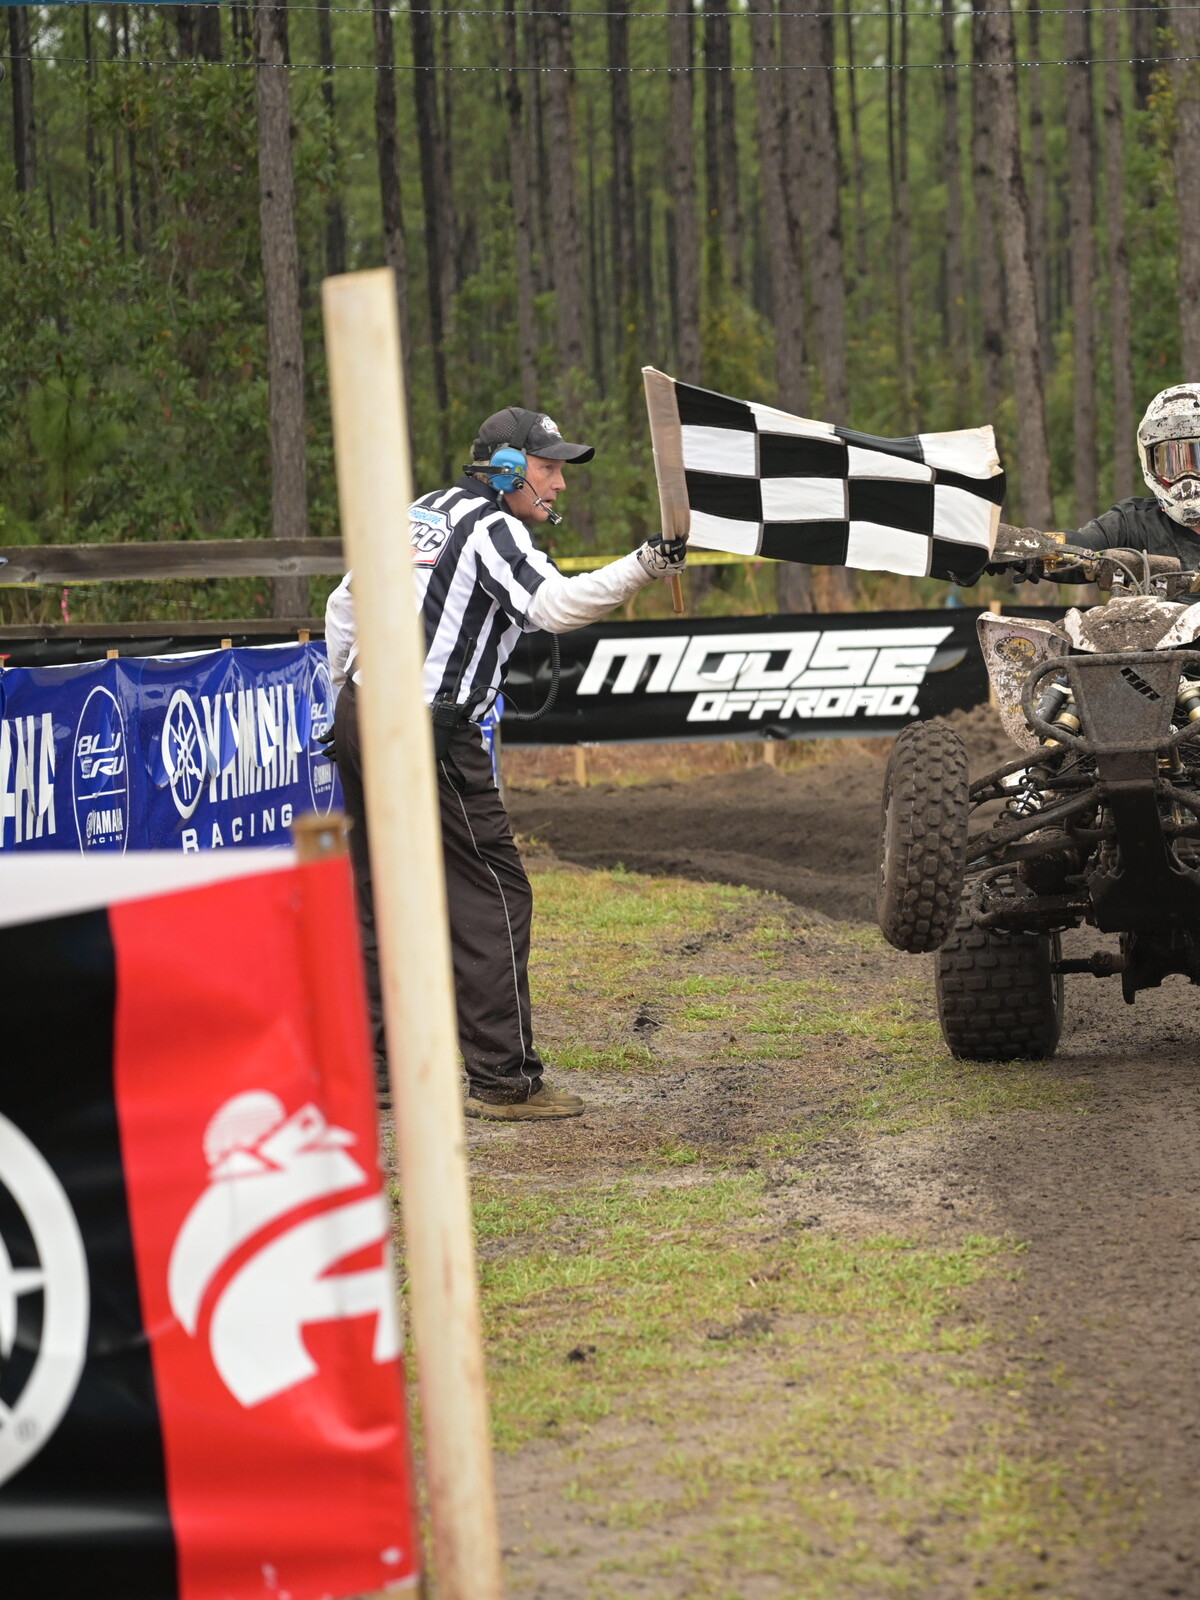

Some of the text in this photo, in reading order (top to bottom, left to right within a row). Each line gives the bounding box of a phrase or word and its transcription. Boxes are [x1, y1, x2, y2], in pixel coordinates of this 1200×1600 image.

[576, 626, 954, 695] MOOSE
[687, 685, 920, 722] OFFROAD
[200, 683, 302, 803] YAMAHA
[182, 803, 293, 855] RACING
